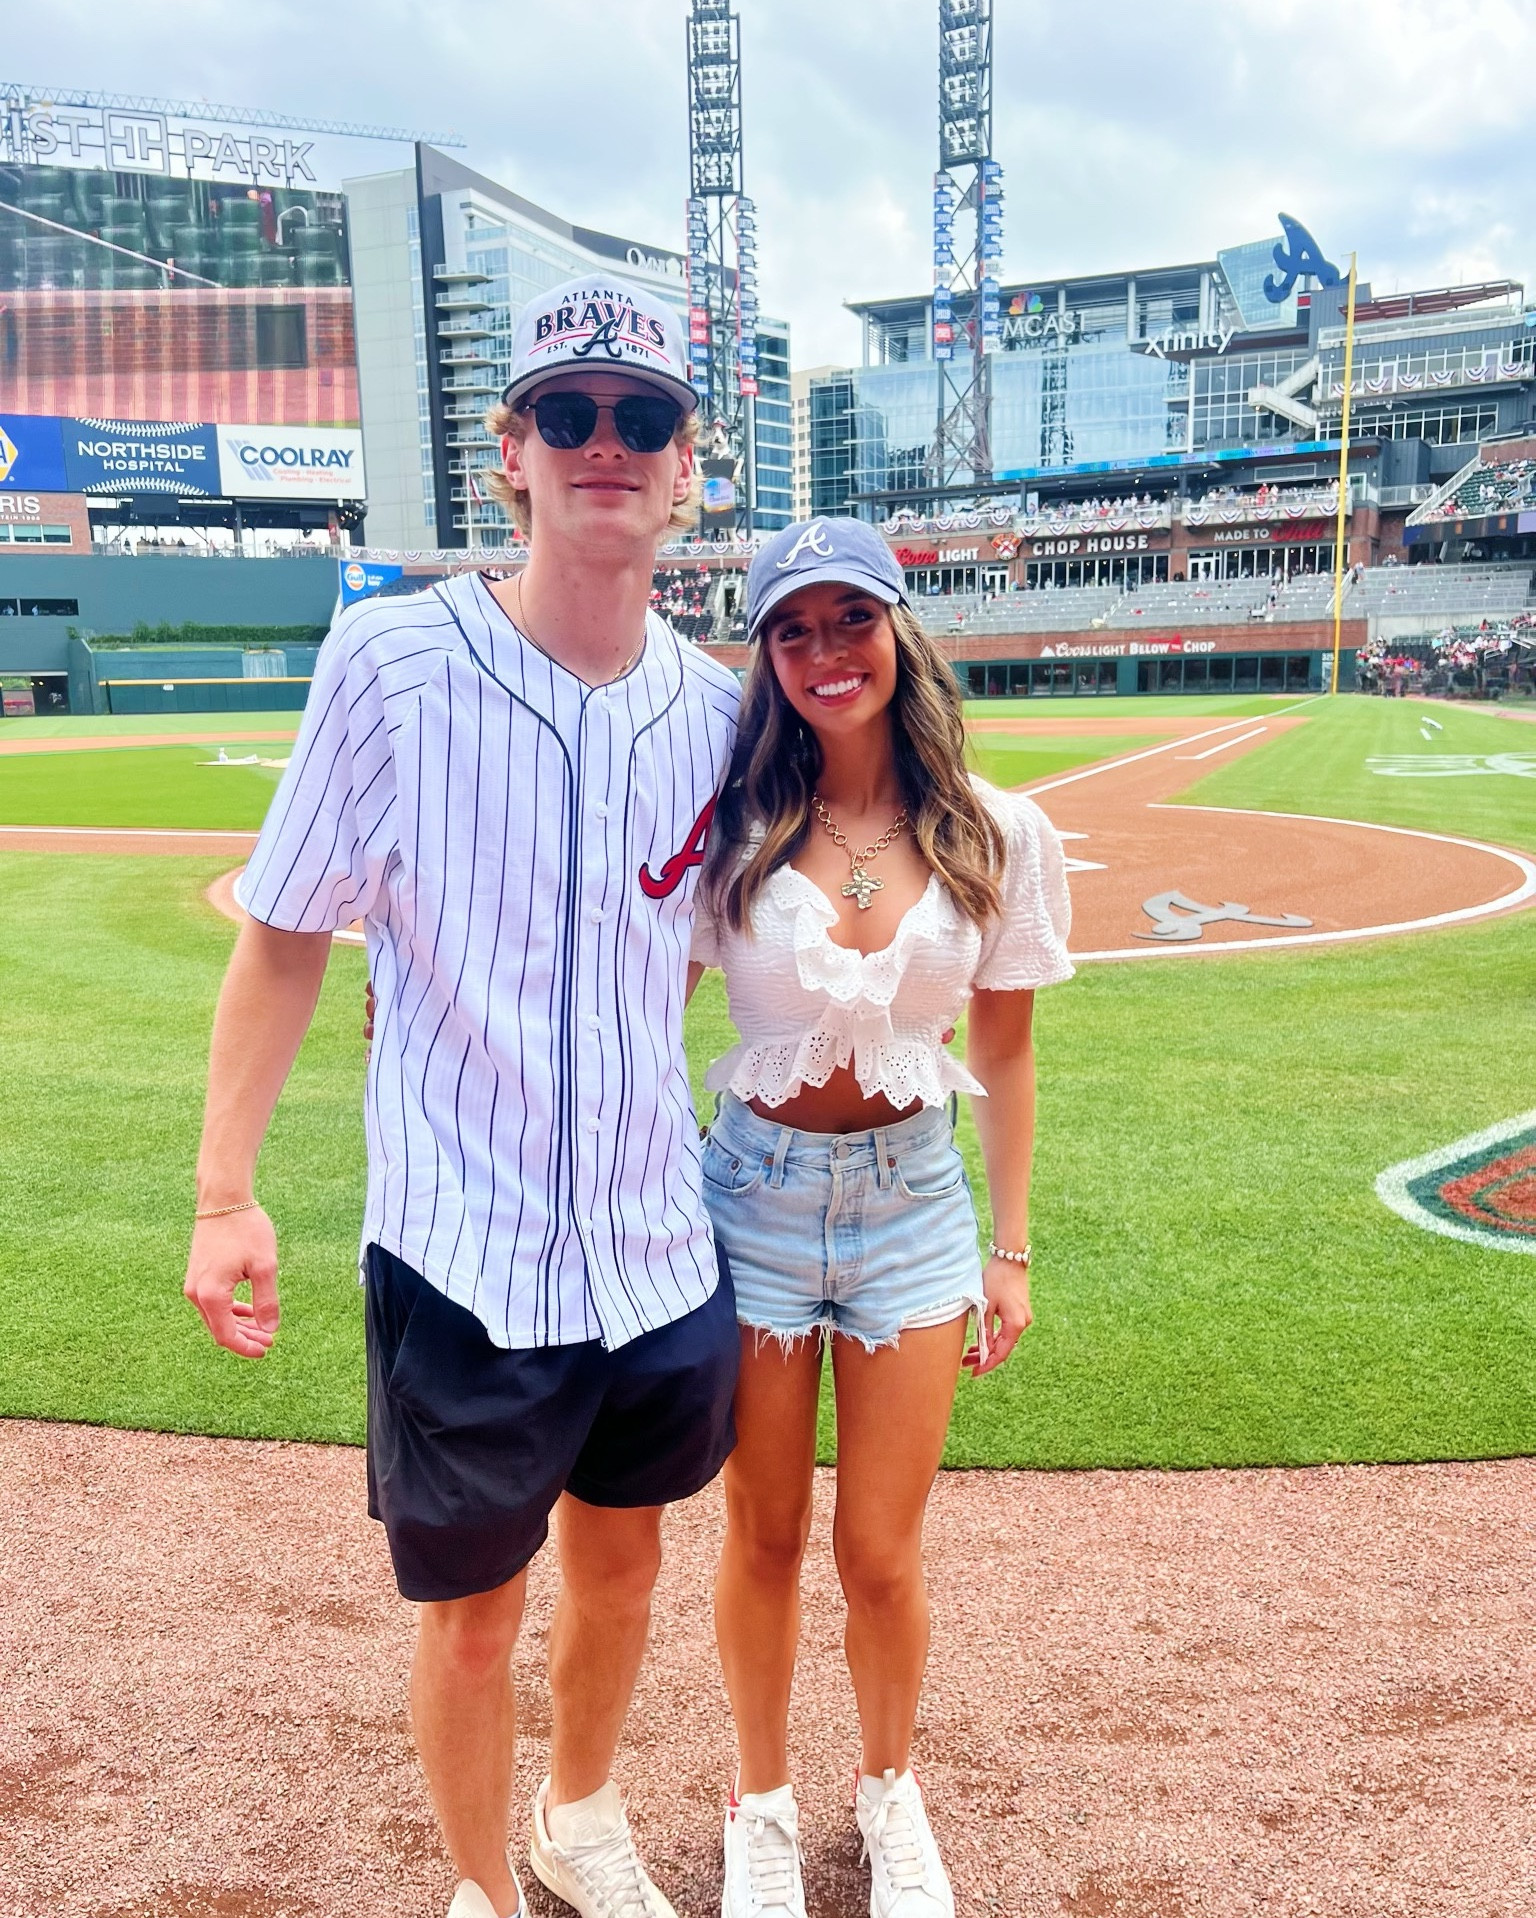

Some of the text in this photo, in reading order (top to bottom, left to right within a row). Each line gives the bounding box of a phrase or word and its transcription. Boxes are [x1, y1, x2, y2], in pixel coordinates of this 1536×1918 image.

[0, 109, 317, 181] IST PARK
[626, 248, 667, 273] OMNI
[562, 290, 634, 306] ATLANTA
[534, 301, 665, 349] BRAVES
[1002, 311, 1089, 340] MCAST
[573, 318, 622, 358] A
[1144, 326, 1234, 359] xfinity
[547, 341, 649, 358] EST. 1871
[77, 441, 206, 460] NORTHSIDE
[240, 446, 354, 468] COOLRAY
[103, 460, 185, 472] HOSPITAL
[0, 495, 41, 514] RIS
[776, 521, 834, 569] A
[1032, 534, 1149, 556] CHOP HOUSE
[1214, 529, 1250, 541] MADE
[1253, 527, 1270, 539] TO
[938, 547, 980, 562] LIGHT
[1092, 644, 1126, 656] LIGHT
[1129, 642, 1170, 655] BELOW
[1183, 640, 1216, 653] CHOP
